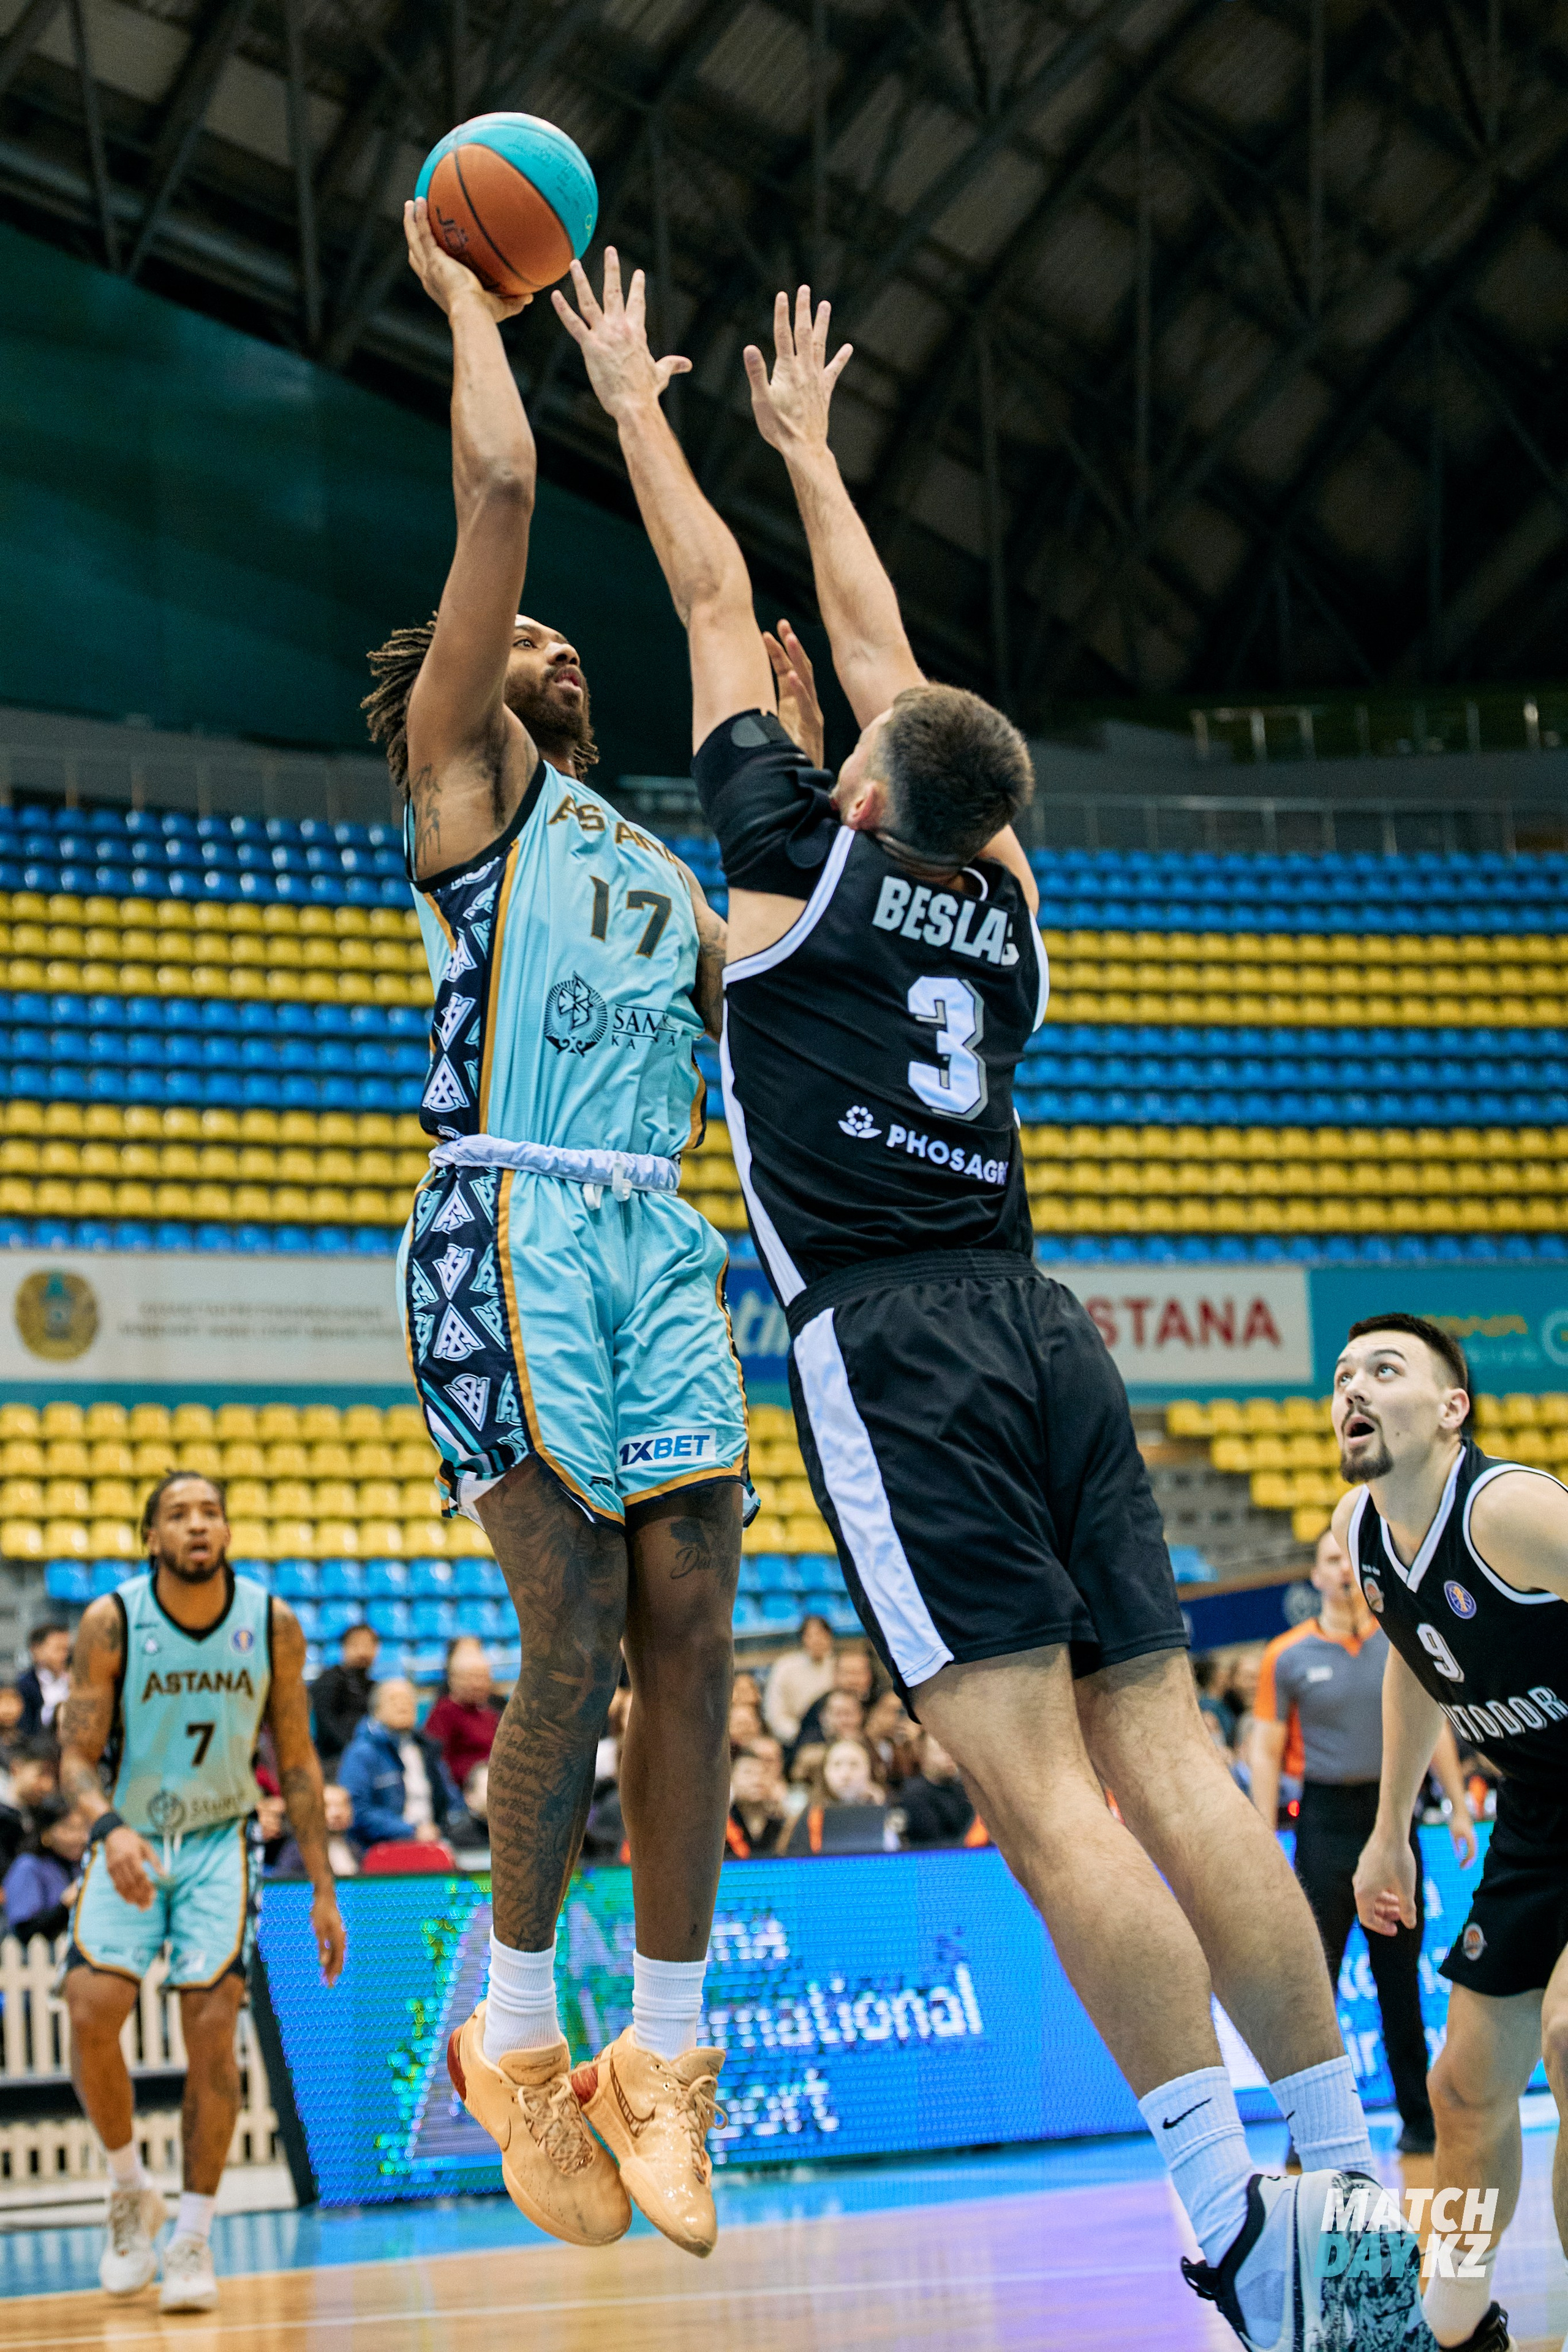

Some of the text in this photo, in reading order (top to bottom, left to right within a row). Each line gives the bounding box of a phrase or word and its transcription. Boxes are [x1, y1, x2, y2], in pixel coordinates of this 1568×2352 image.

[589, 875, 673, 959] 17
[908, 976, 988, 1121] 3
[1087, 1296, 1284, 1350] STANA
[619, 1435, 710, 1466] 1XBET
[1416, 1623, 1464, 1683] 9
[141, 1668, 255, 1704] ASTANA
[186, 1720, 216, 1768] 7
